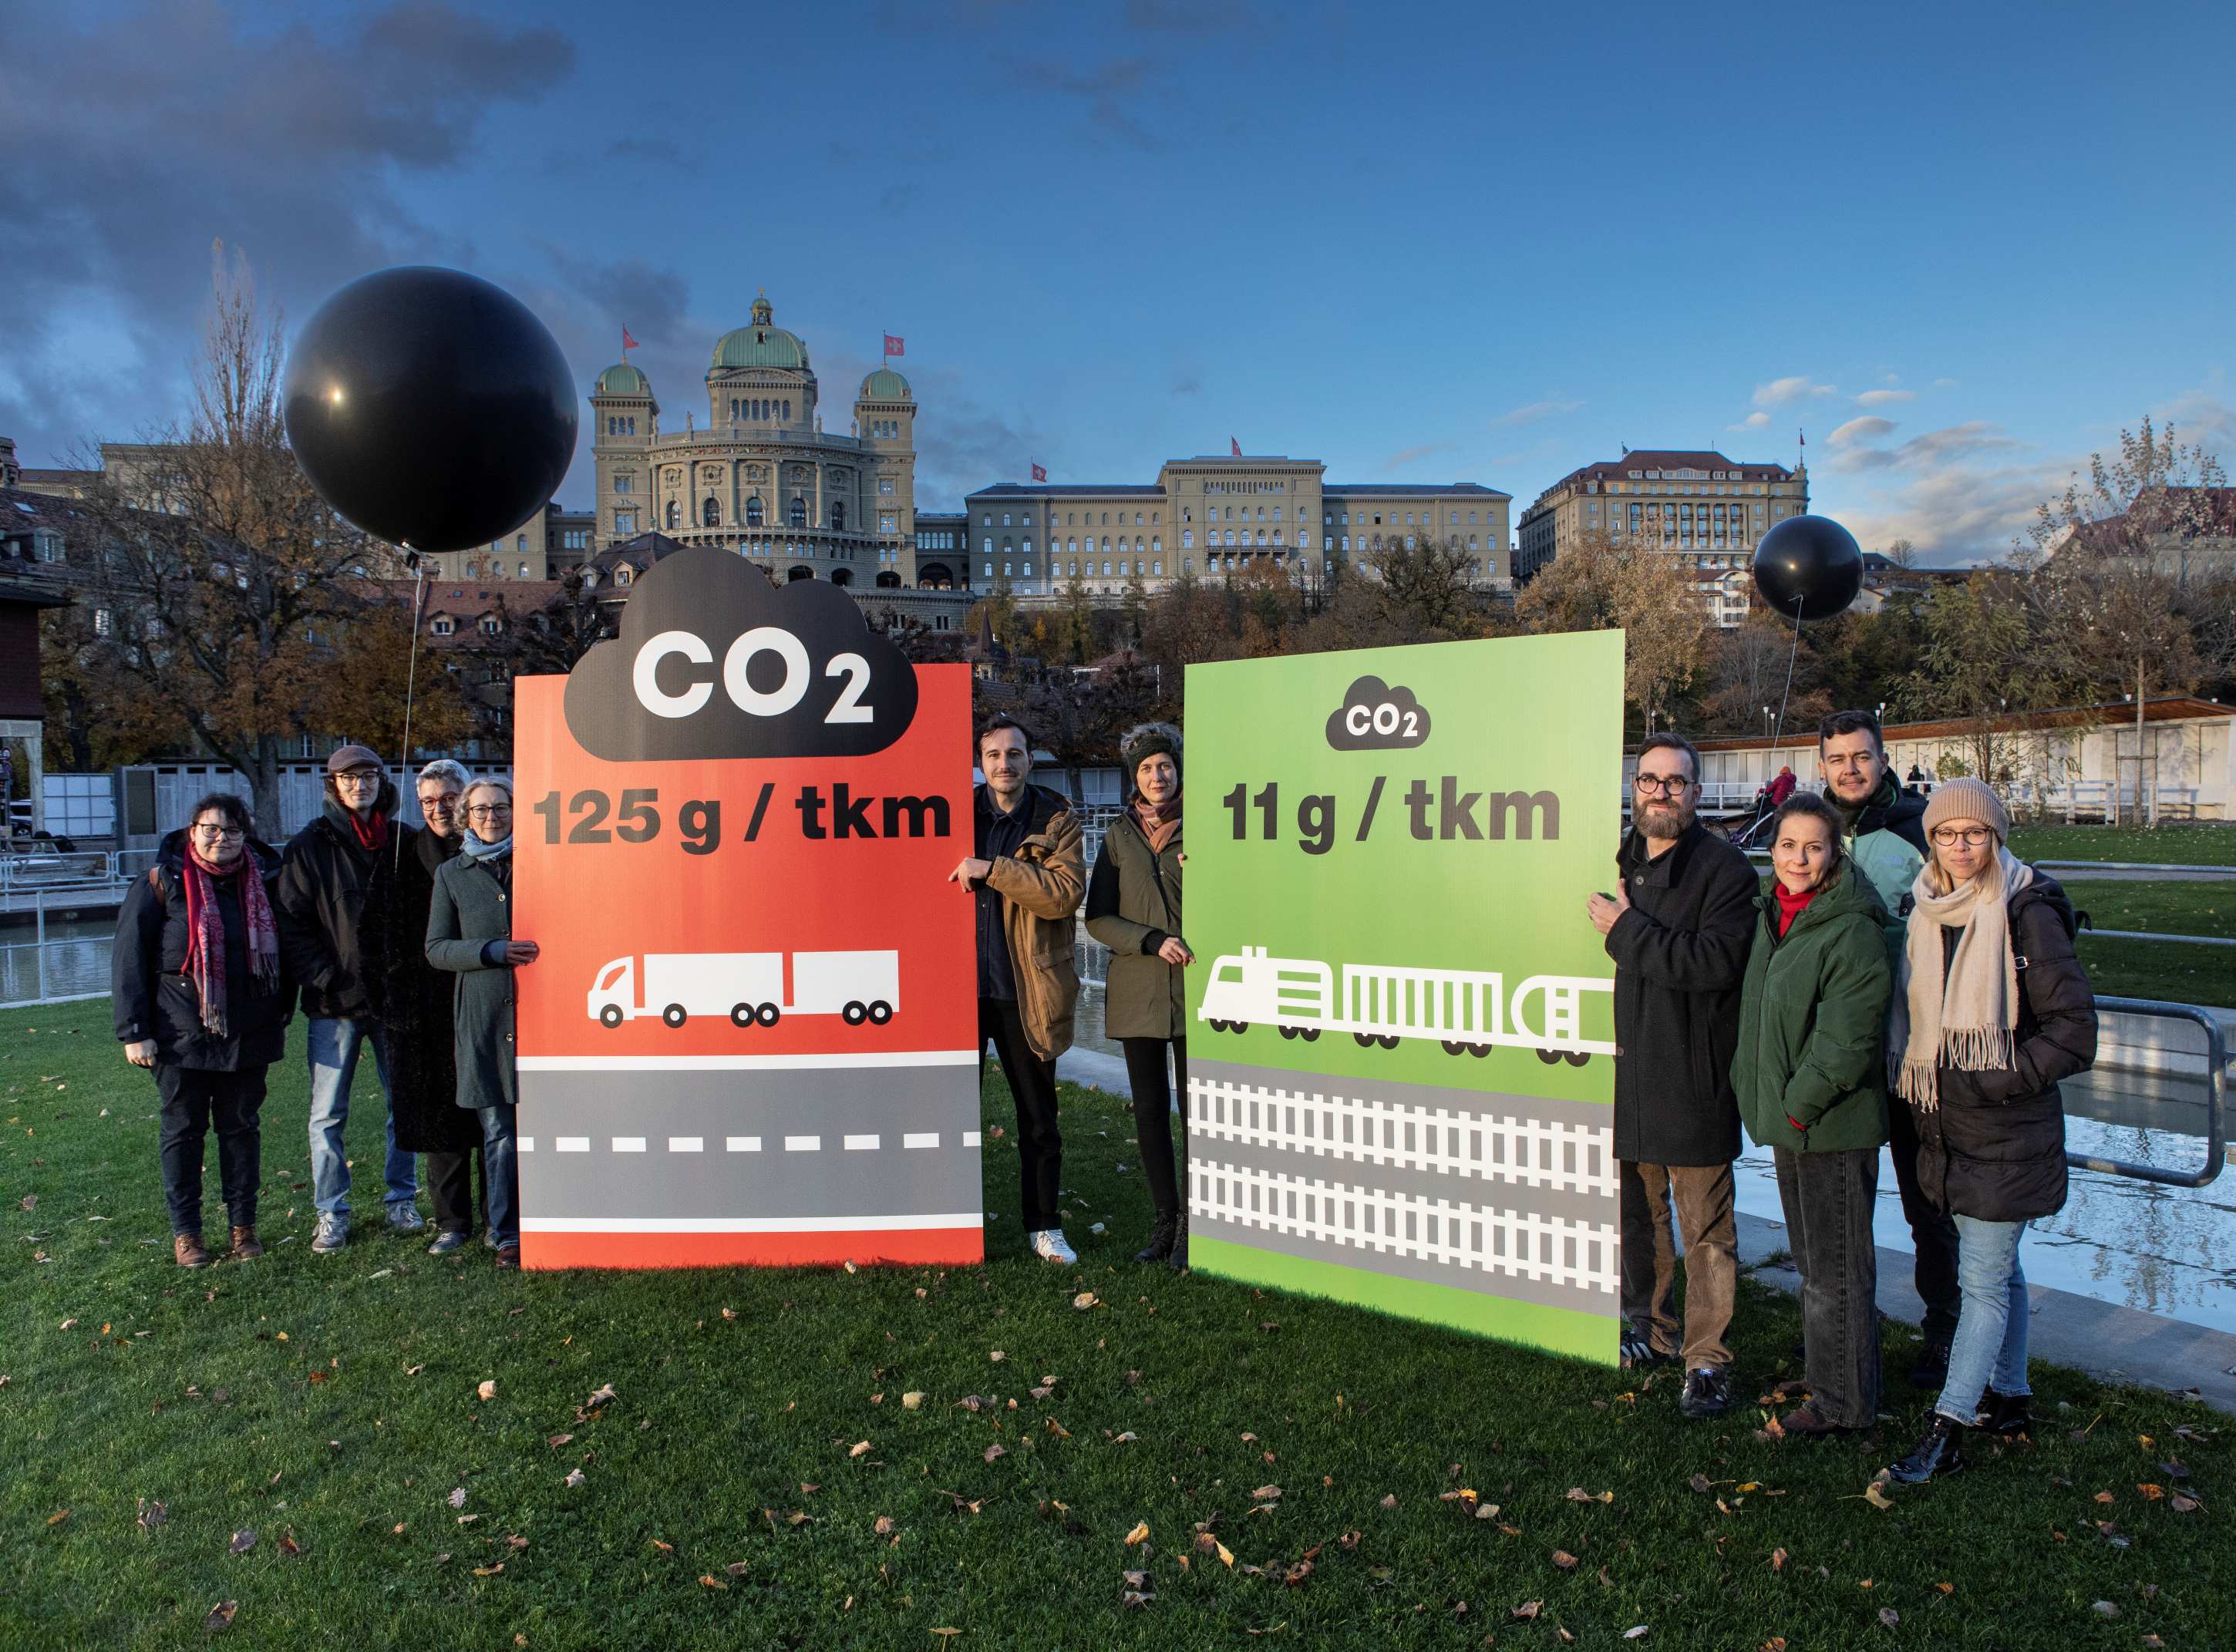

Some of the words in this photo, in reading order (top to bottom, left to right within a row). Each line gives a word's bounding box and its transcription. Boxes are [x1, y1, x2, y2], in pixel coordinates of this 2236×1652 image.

[632, 626, 874, 724] CO2
[1345, 702, 1419, 738] CO2
[534, 788, 661, 845] 125
[679, 797, 721, 856] g
[744, 782, 776, 842] /
[795, 782, 951, 840] tkm
[1223, 782, 1278, 840] 11
[1297, 795, 1336, 855] g
[1355, 776, 1387, 842] /
[1404, 776, 1560, 840] tkm
